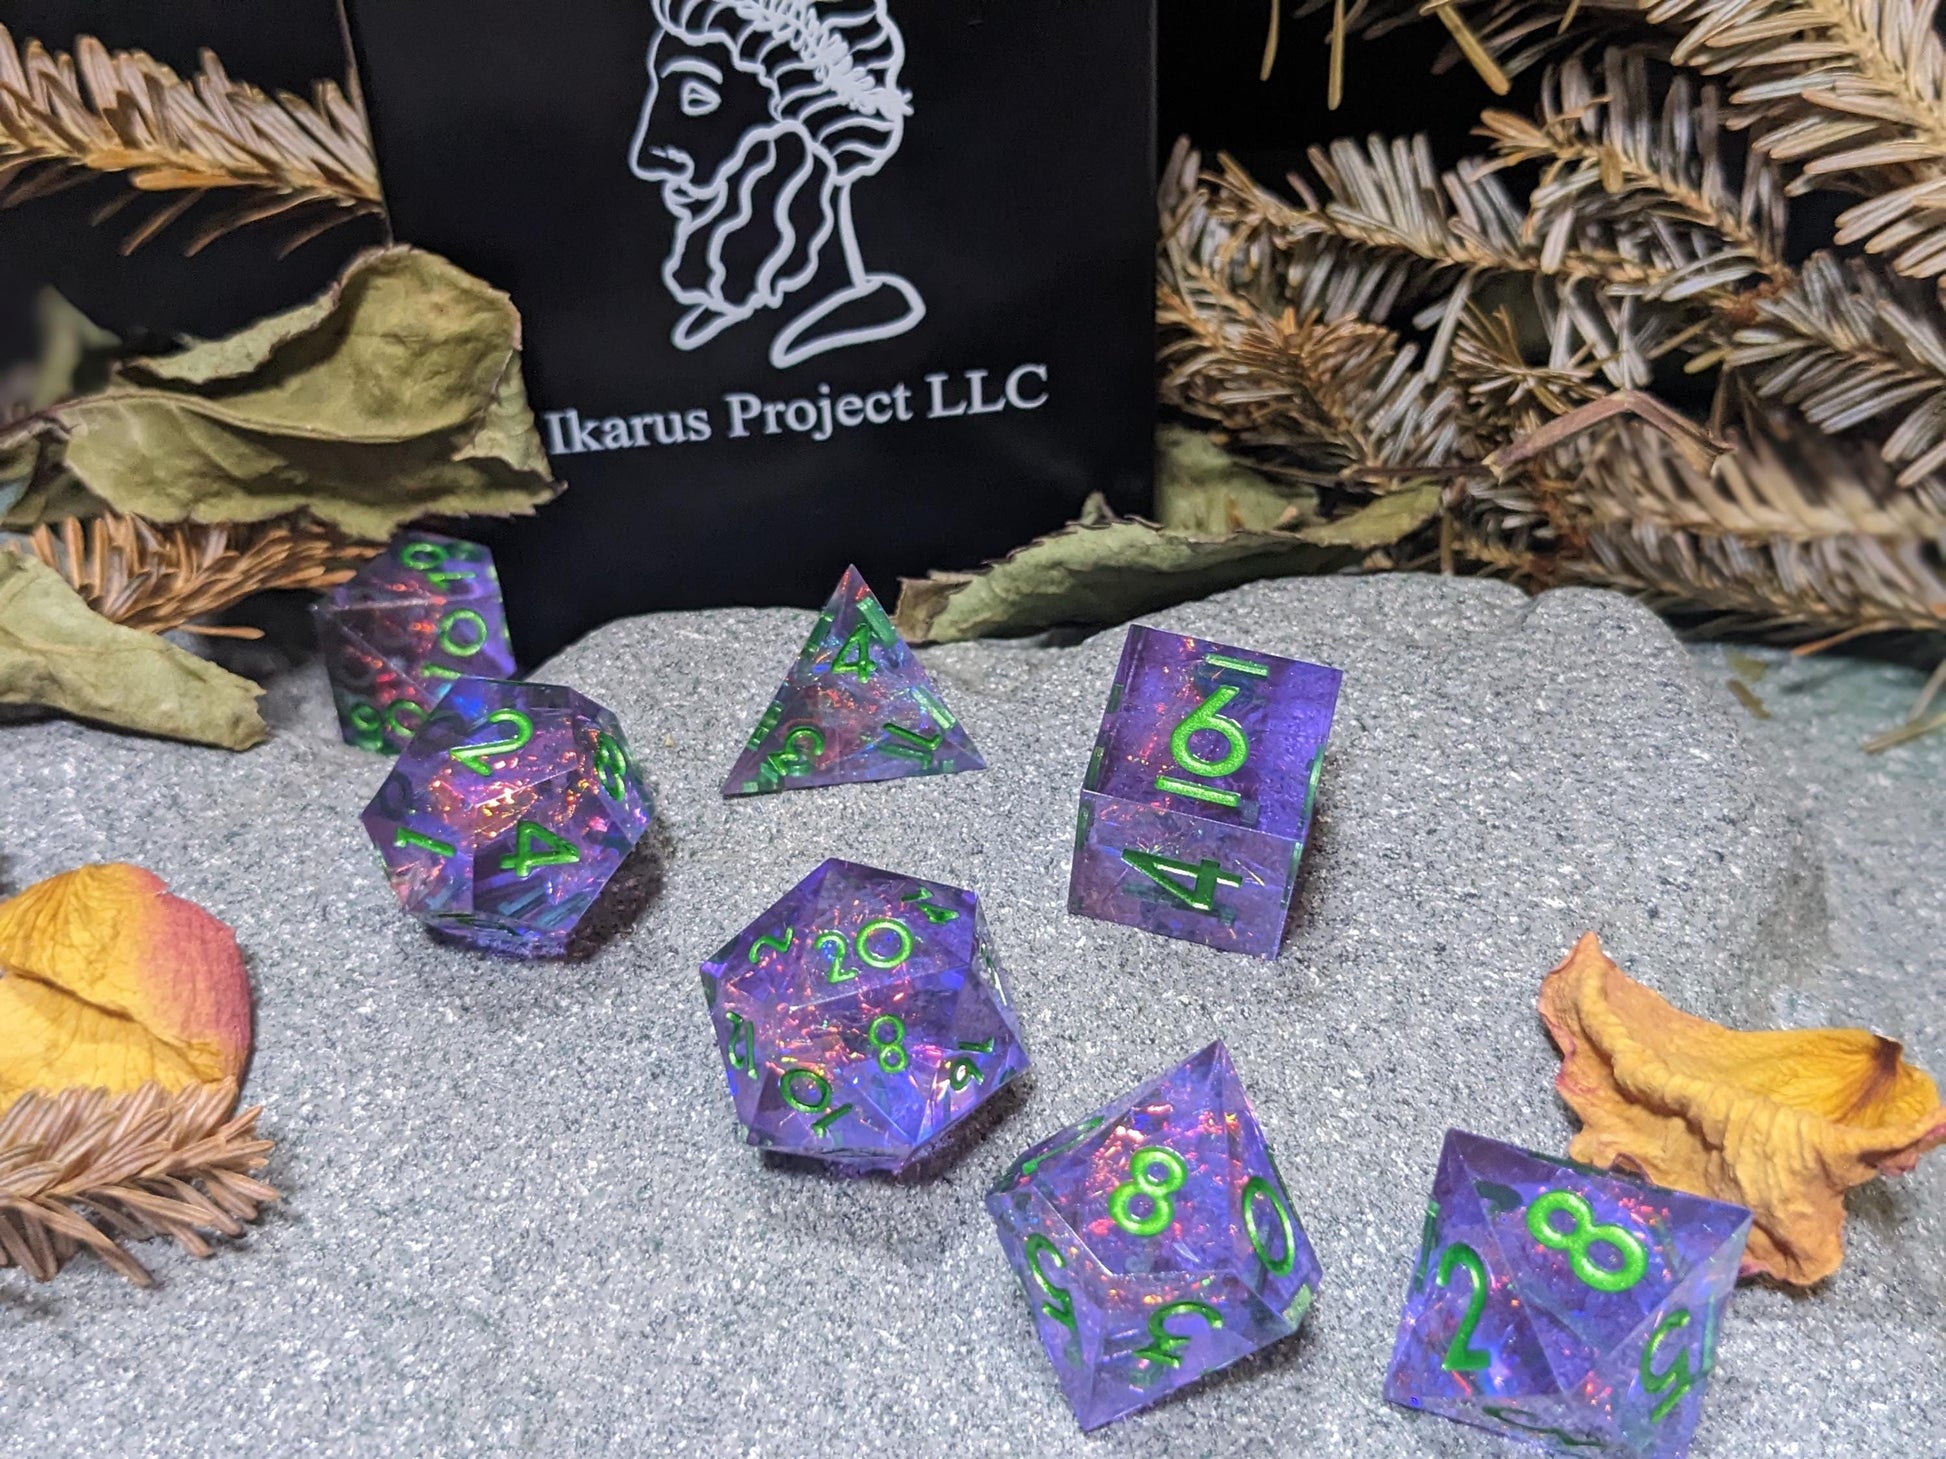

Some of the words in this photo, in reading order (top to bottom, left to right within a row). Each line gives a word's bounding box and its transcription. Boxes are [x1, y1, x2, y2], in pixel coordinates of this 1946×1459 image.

[544, 408, 711, 455] Ikarus
[724, 383, 914, 441] Project
[925, 364, 1049, 419] LLC
[831, 622, 877, 684] 4
[449, 708, 533, 777] 2
[499, 819, 581, 878] 4
[1120, 848, 1244, 911] 4
[814, 917, 913, 984] 20
[868, 1013, 910, 1075] 8
[1108, 1146, 1188, 1237] 8
[1526, 1189, 1650, 1293] 8
[1435, 1242, 1492, 1373] 2
